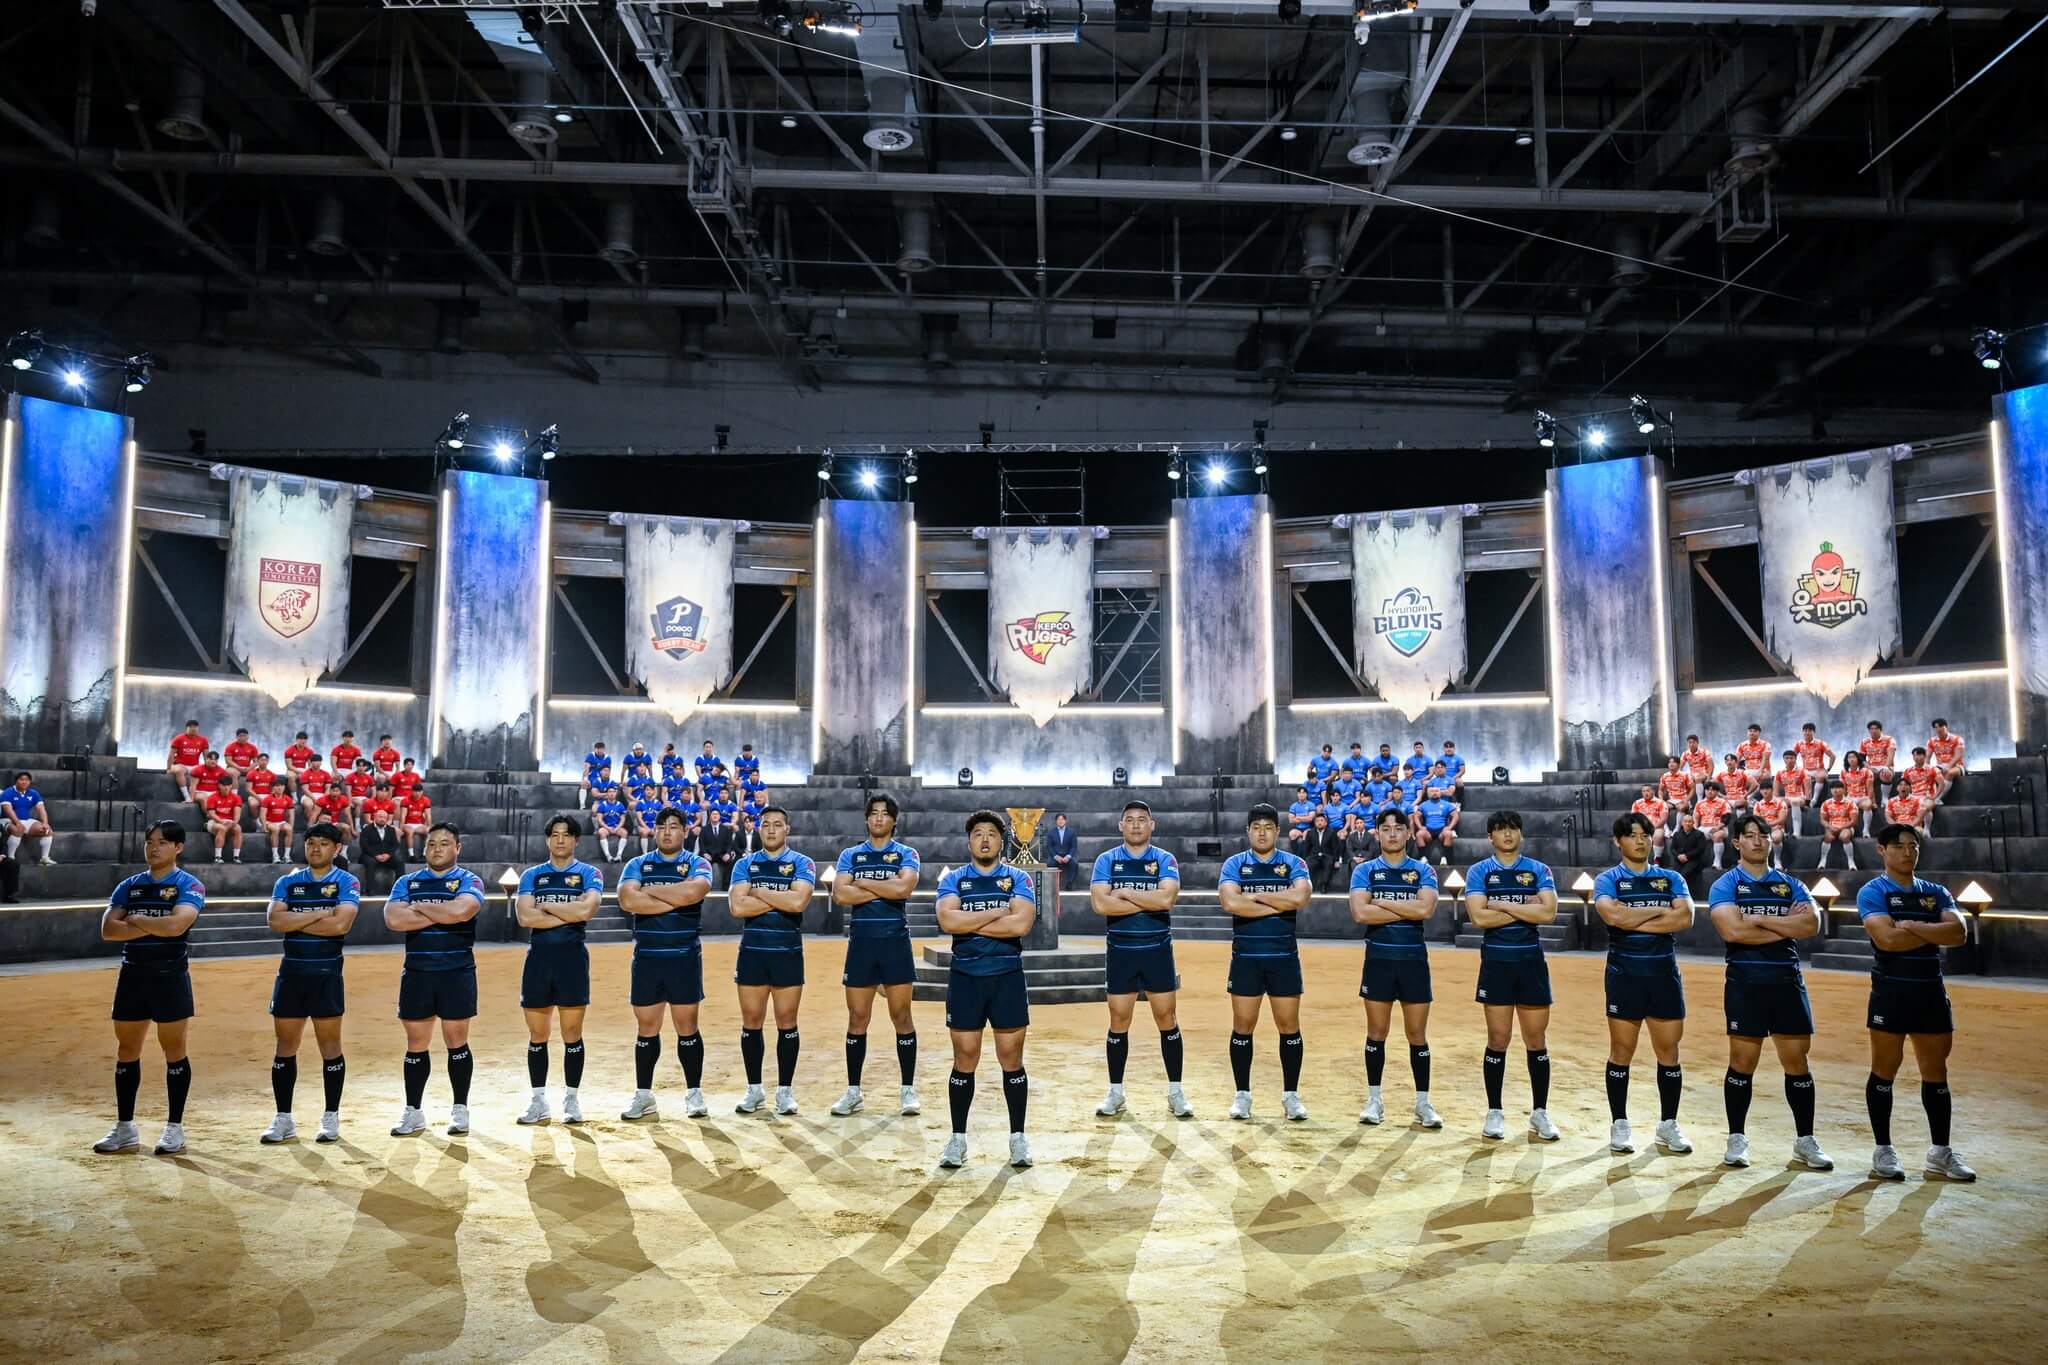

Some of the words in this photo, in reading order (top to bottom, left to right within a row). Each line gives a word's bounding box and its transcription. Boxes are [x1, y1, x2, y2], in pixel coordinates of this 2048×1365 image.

[264, 561, 317, 576] KOREA
[1038, 622, 1070, 630] KEPCO
[1373, 612, 1443, 635] GLOVIS
